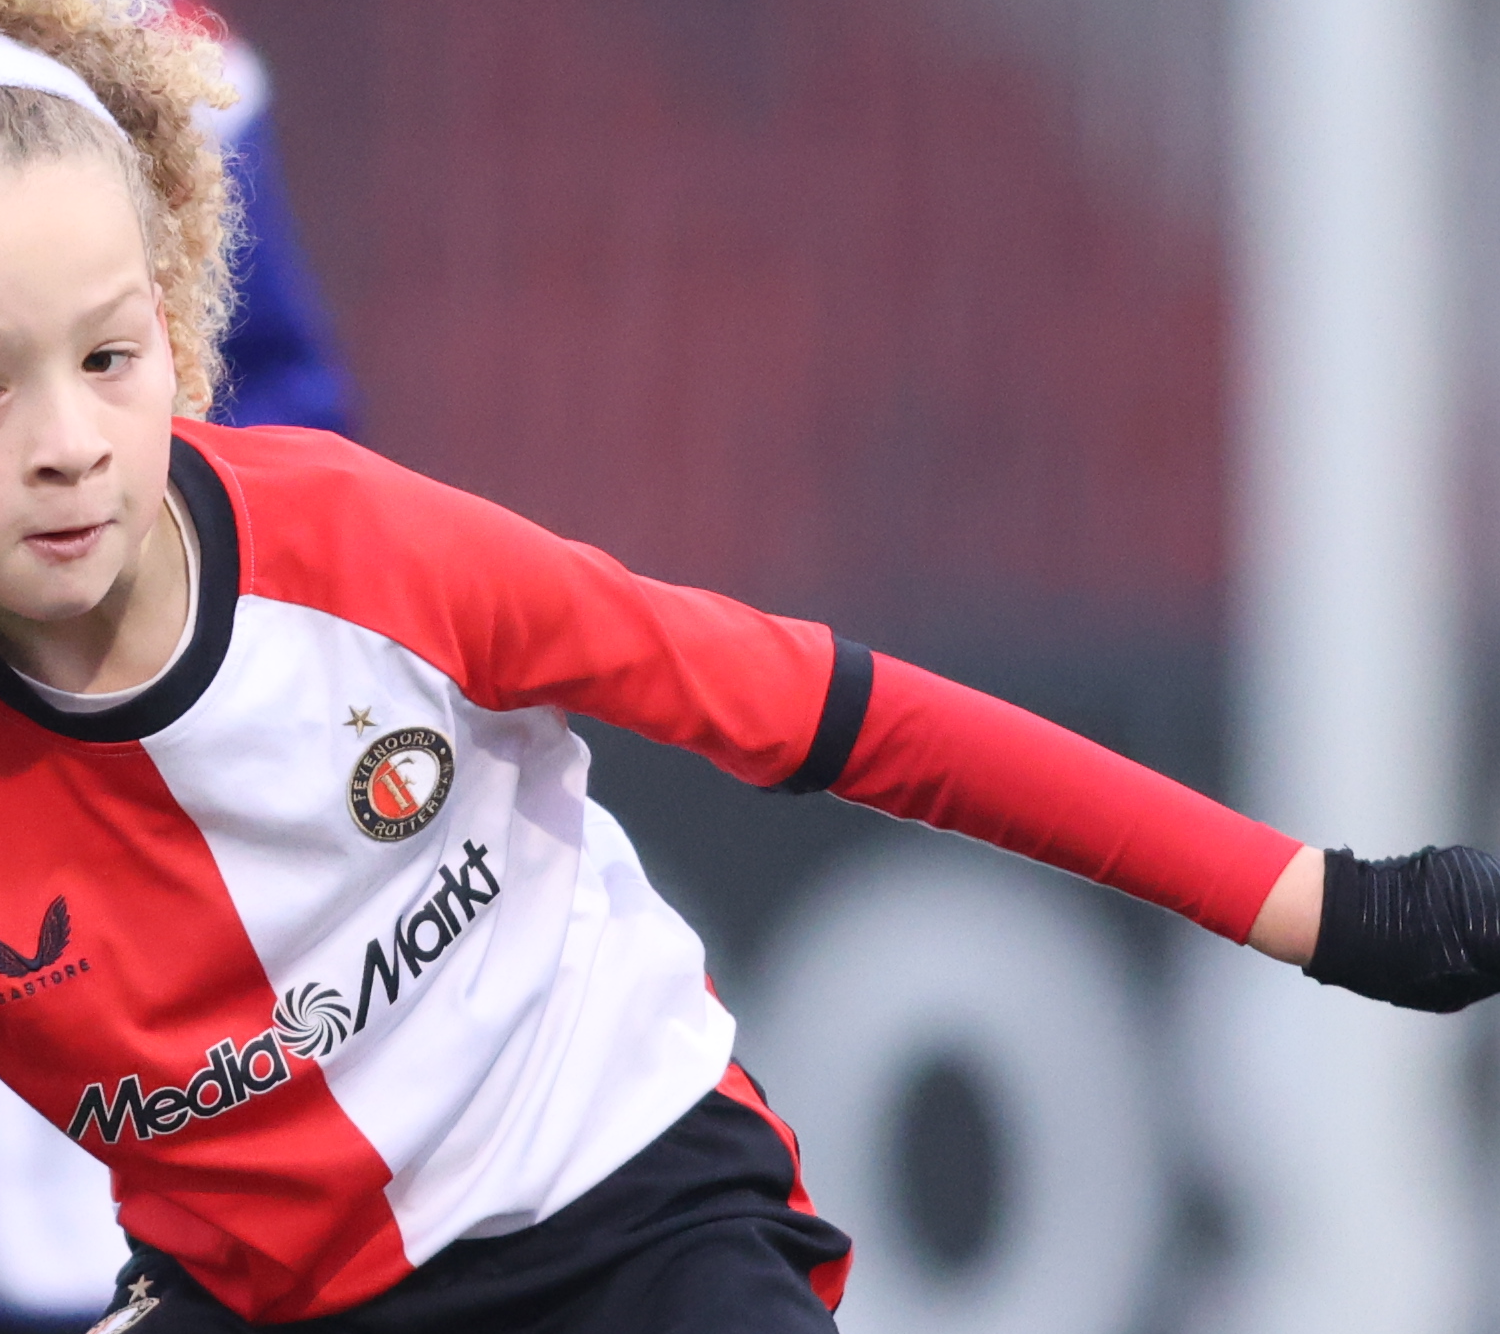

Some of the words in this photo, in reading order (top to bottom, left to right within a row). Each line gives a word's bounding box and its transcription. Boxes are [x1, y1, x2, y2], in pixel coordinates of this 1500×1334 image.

[353, 730, 437, 802] FEYENOORD
[67, 1027, 291, 1144] Media
[352, 838, 501, 1036] Markt
